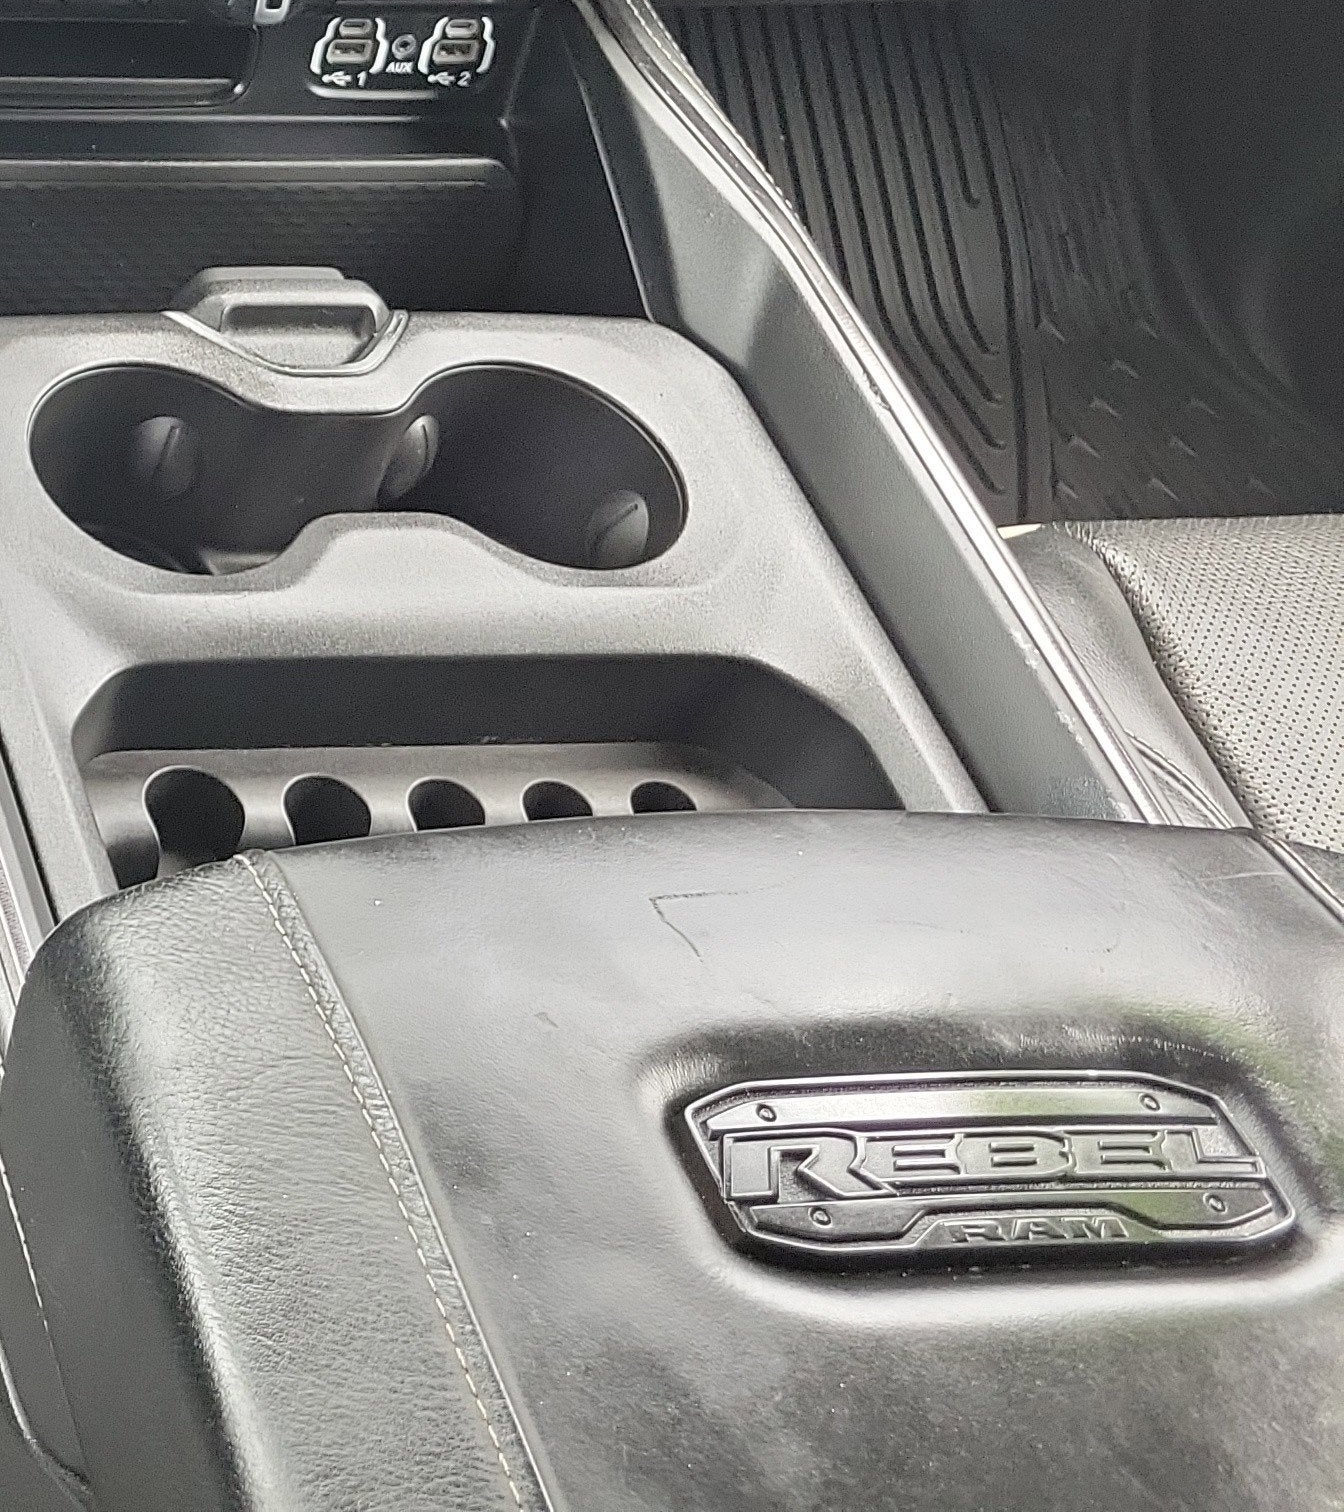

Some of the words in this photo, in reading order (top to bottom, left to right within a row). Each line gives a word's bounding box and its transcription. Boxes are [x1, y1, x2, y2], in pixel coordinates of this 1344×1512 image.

[385, 62, 413, 74] AUX
[457, 72, 472, 87] 2
[720, 1124, 1270, 1203] REBEL
[942, 1216, 1130, 1244] RAM
